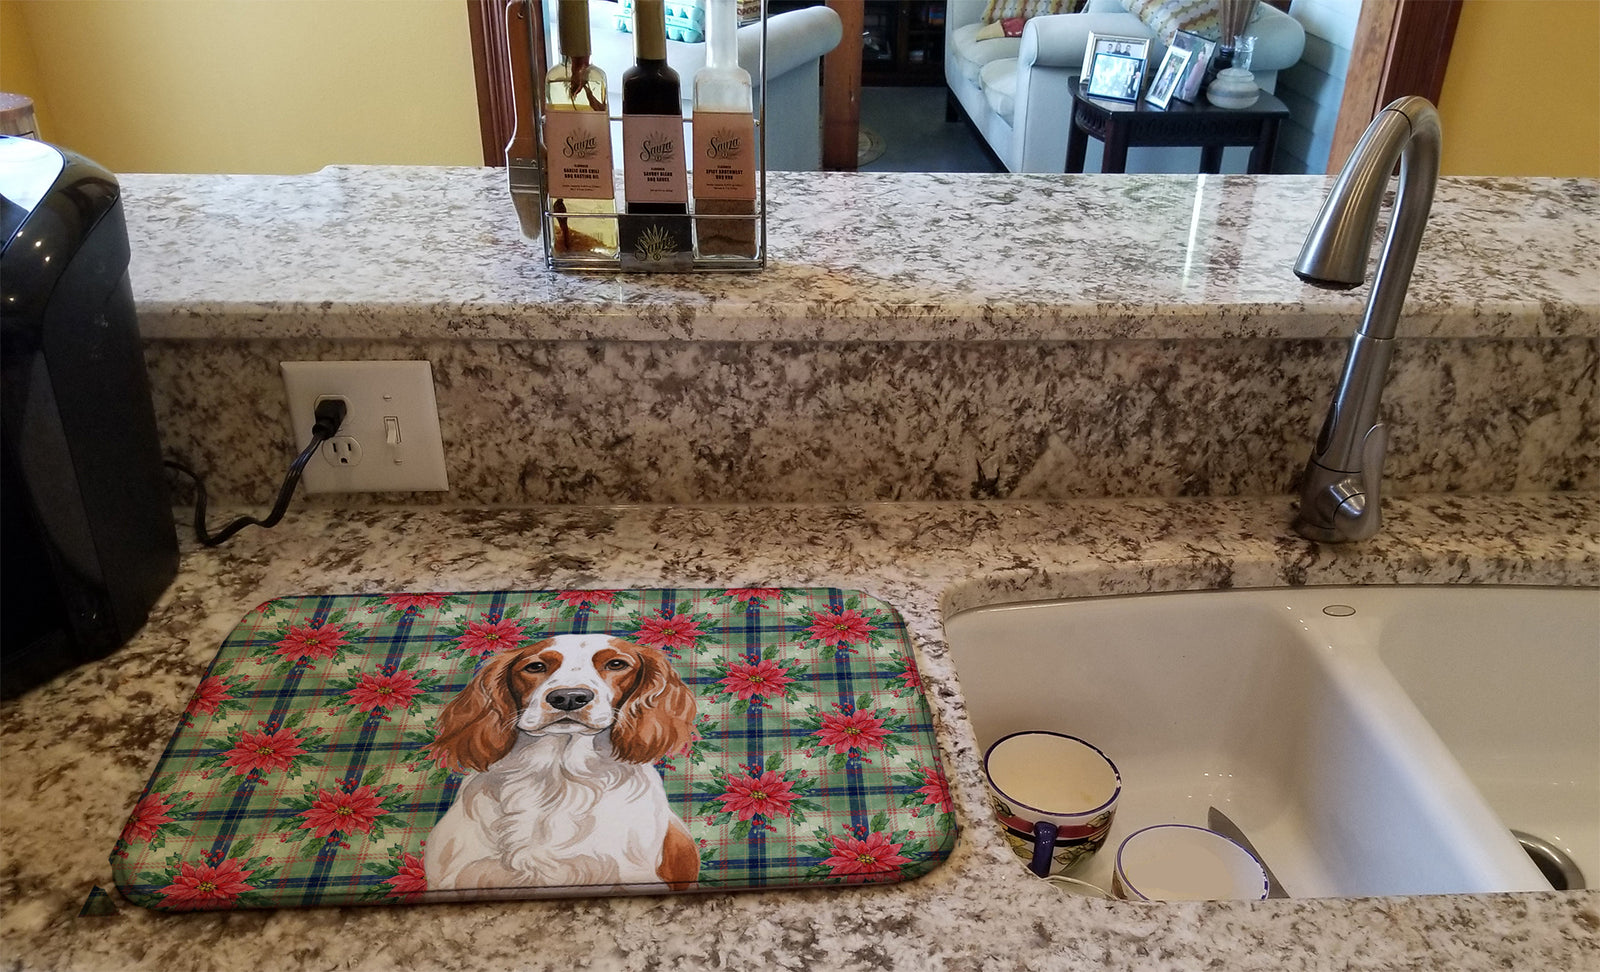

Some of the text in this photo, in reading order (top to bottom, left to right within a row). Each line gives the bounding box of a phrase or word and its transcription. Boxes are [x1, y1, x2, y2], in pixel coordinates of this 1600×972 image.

[563, 136, 597, 158] Sauza
[639, 140, 674, 162] Sauza
[706, 137, 740, 159] Sauza
